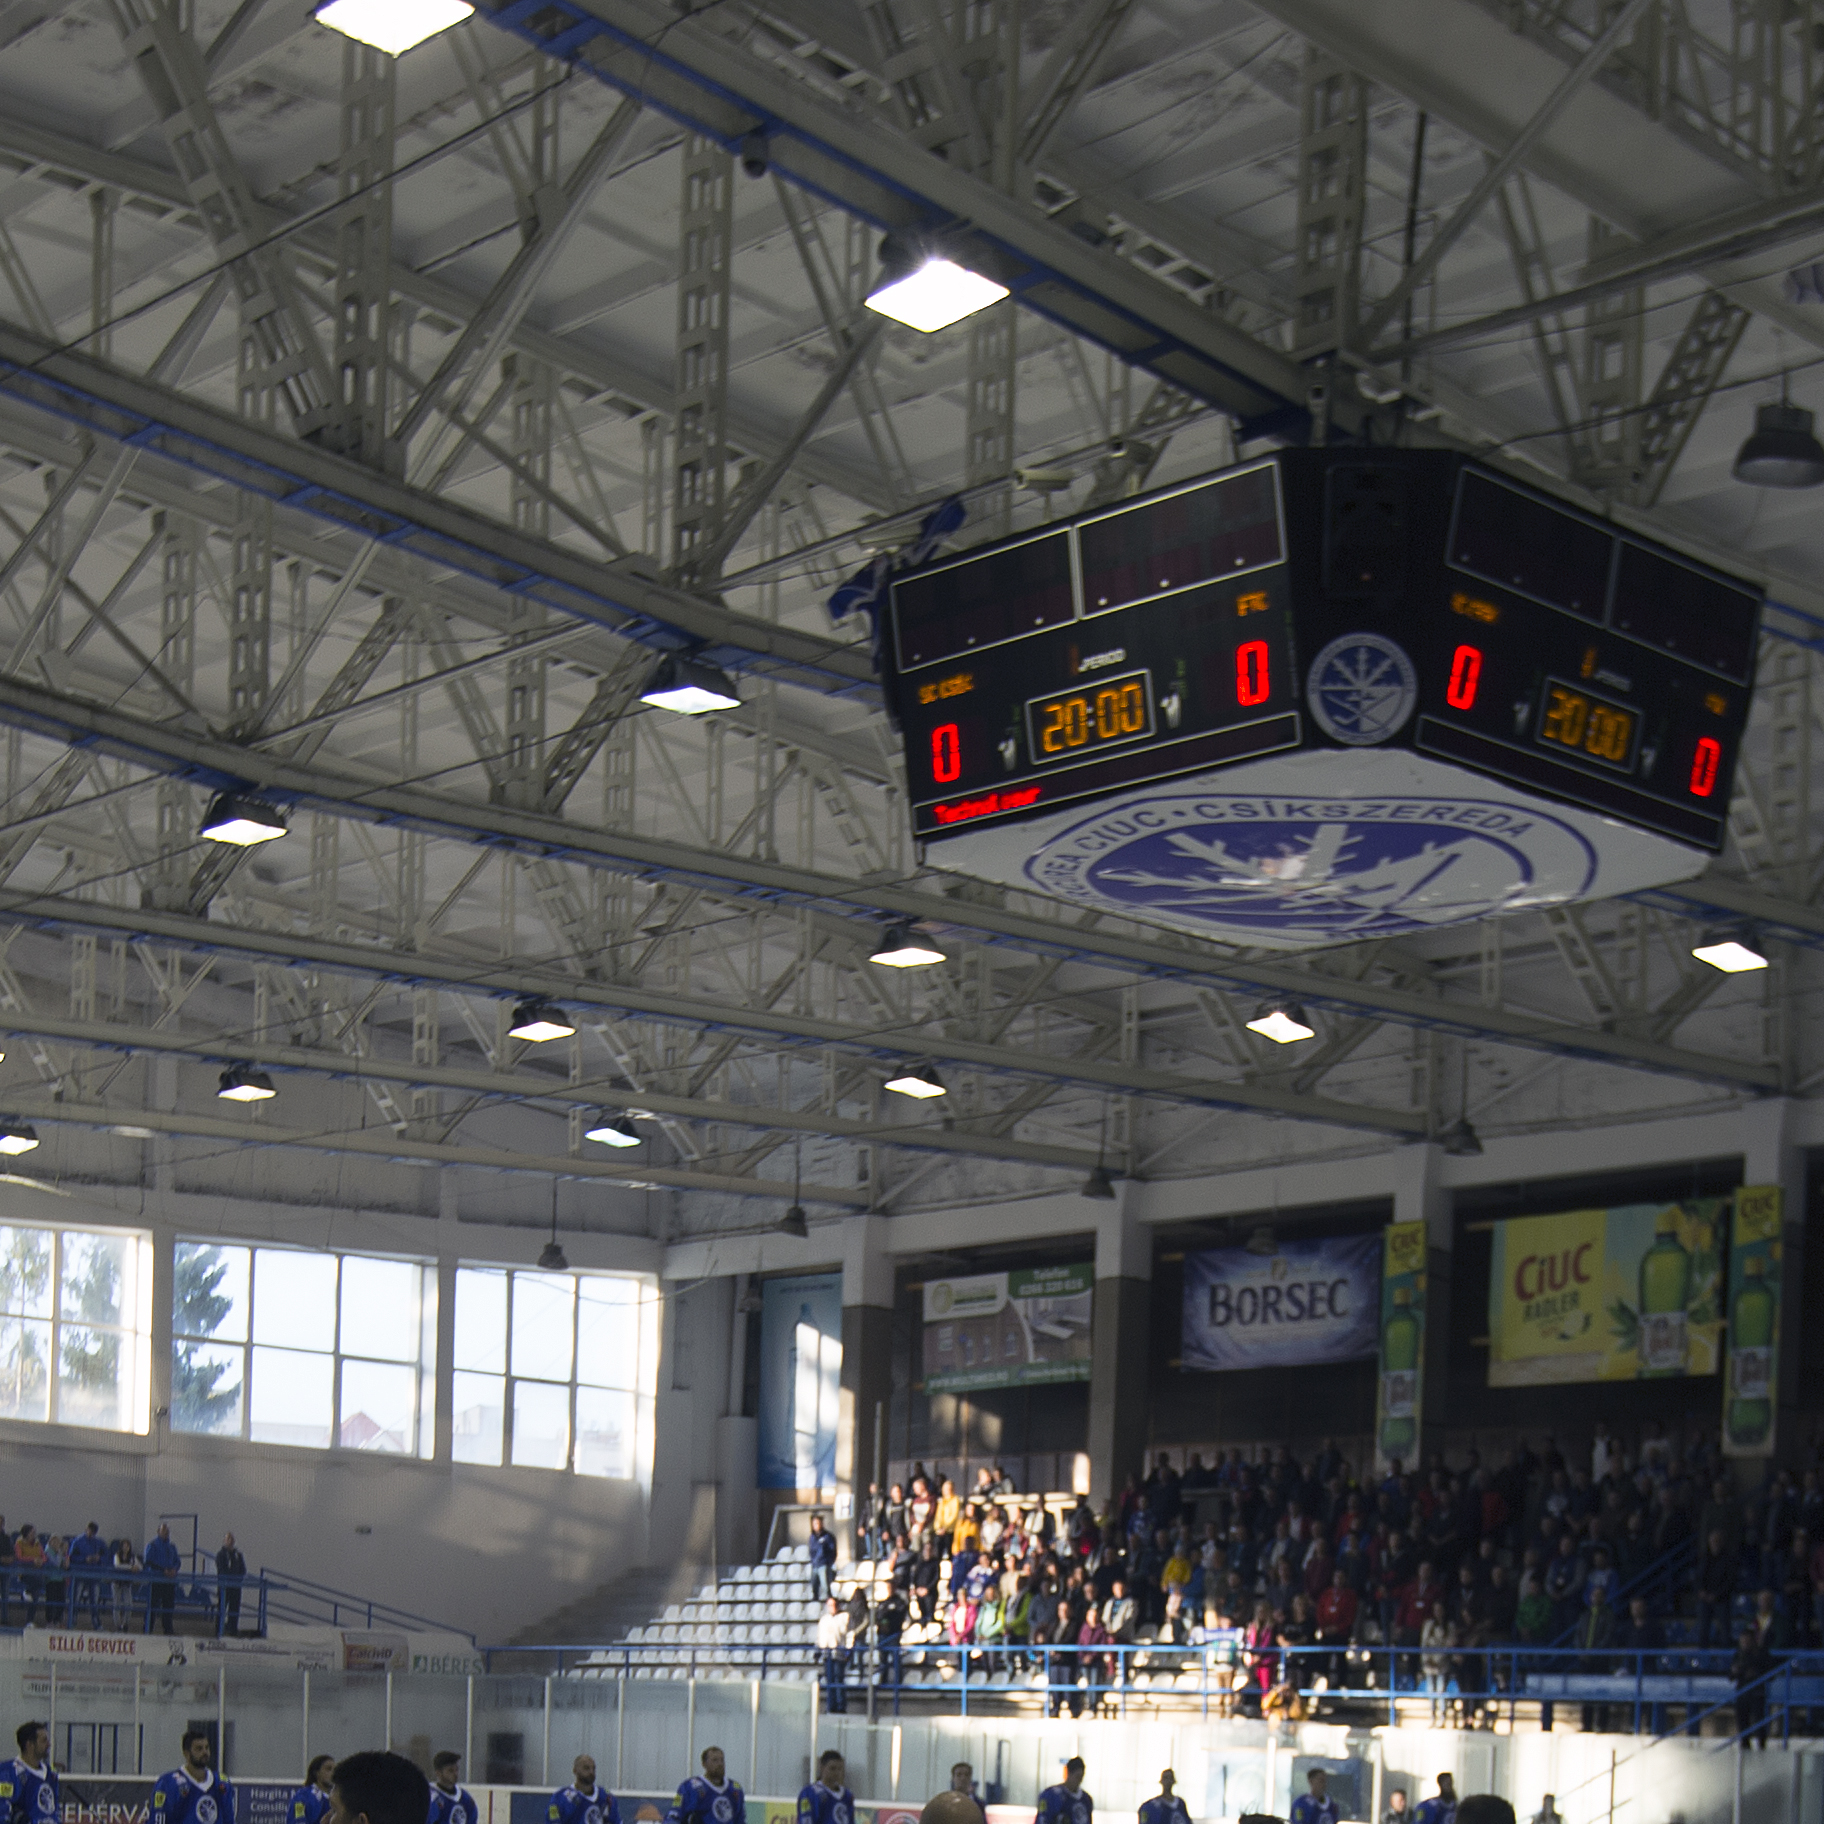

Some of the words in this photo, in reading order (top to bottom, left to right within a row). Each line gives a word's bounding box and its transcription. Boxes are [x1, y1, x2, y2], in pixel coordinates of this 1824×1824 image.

[1235, 639, 1270, 707] 0
[1446, 644, 1484, 711] 0
[1042, 682, 1146, 754] 20:00
[931, 722, 962, 783] 0
[1689, 735, 1723, 797] 0
[1074, 810, 1166, 851] CIUC
[1208, 1278, 1350, 1327] BORSEC
[87, 1638, 136, 1655] SERVICE
